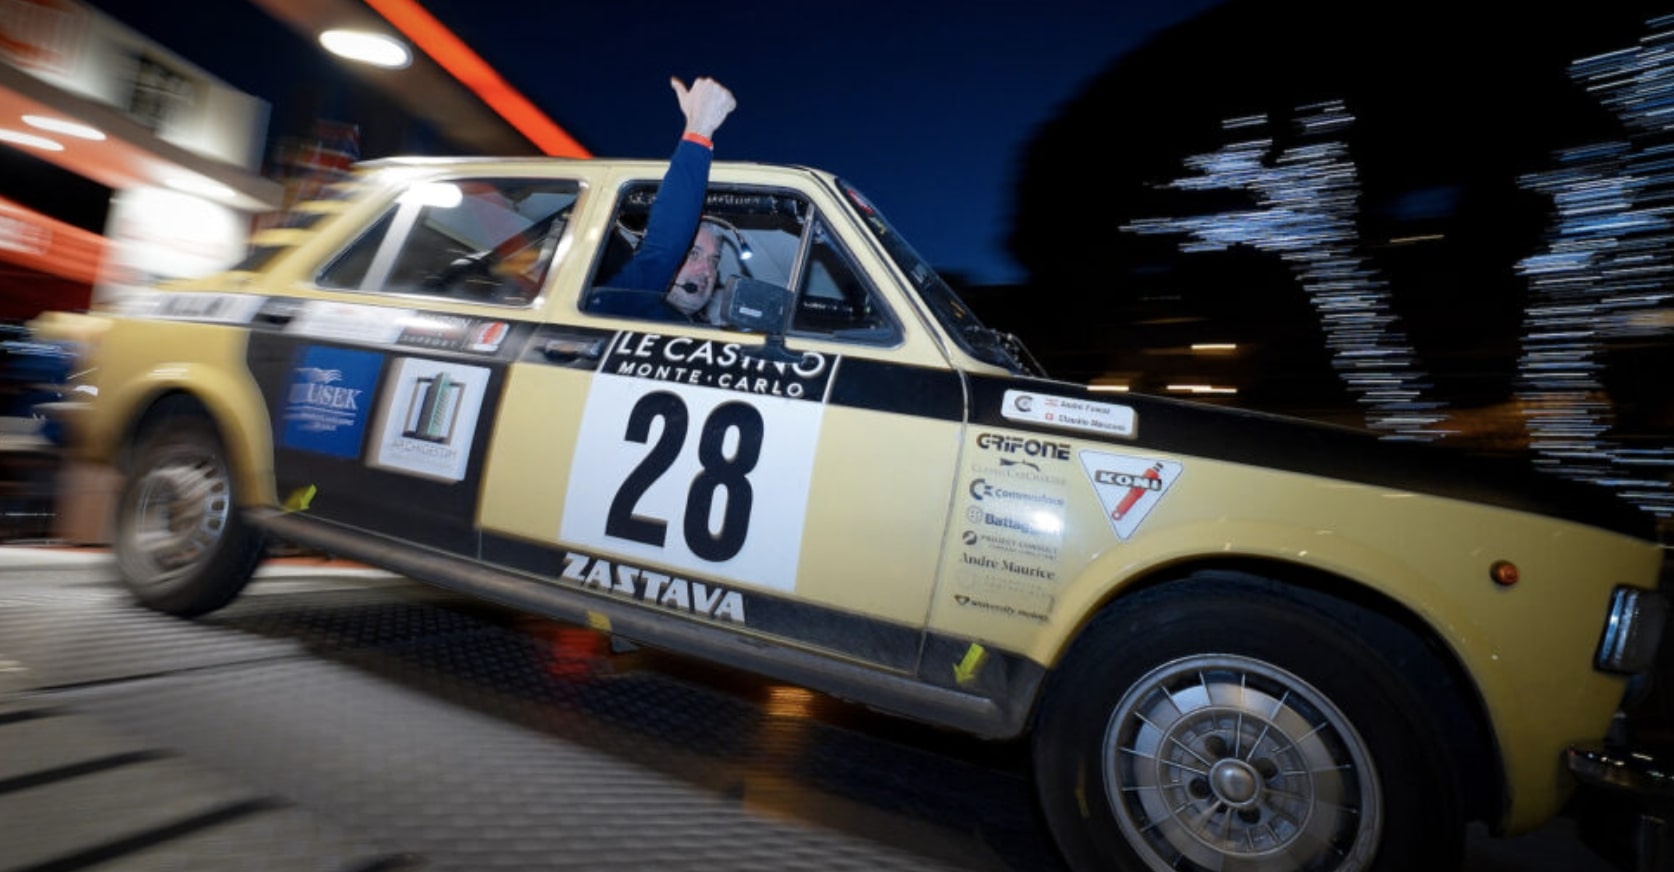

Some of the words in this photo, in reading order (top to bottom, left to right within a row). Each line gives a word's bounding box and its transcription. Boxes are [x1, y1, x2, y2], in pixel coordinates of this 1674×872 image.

[615, 331, 661, 357] LE
[307, 384, 363, 410] USEK
[976, 433, 1071, 461] GRIFONE
[605, 389, 764, 562] 28
[1095, 470, 1162, 491] KONI
[561, 551, 746, 624] ZASTAVA
